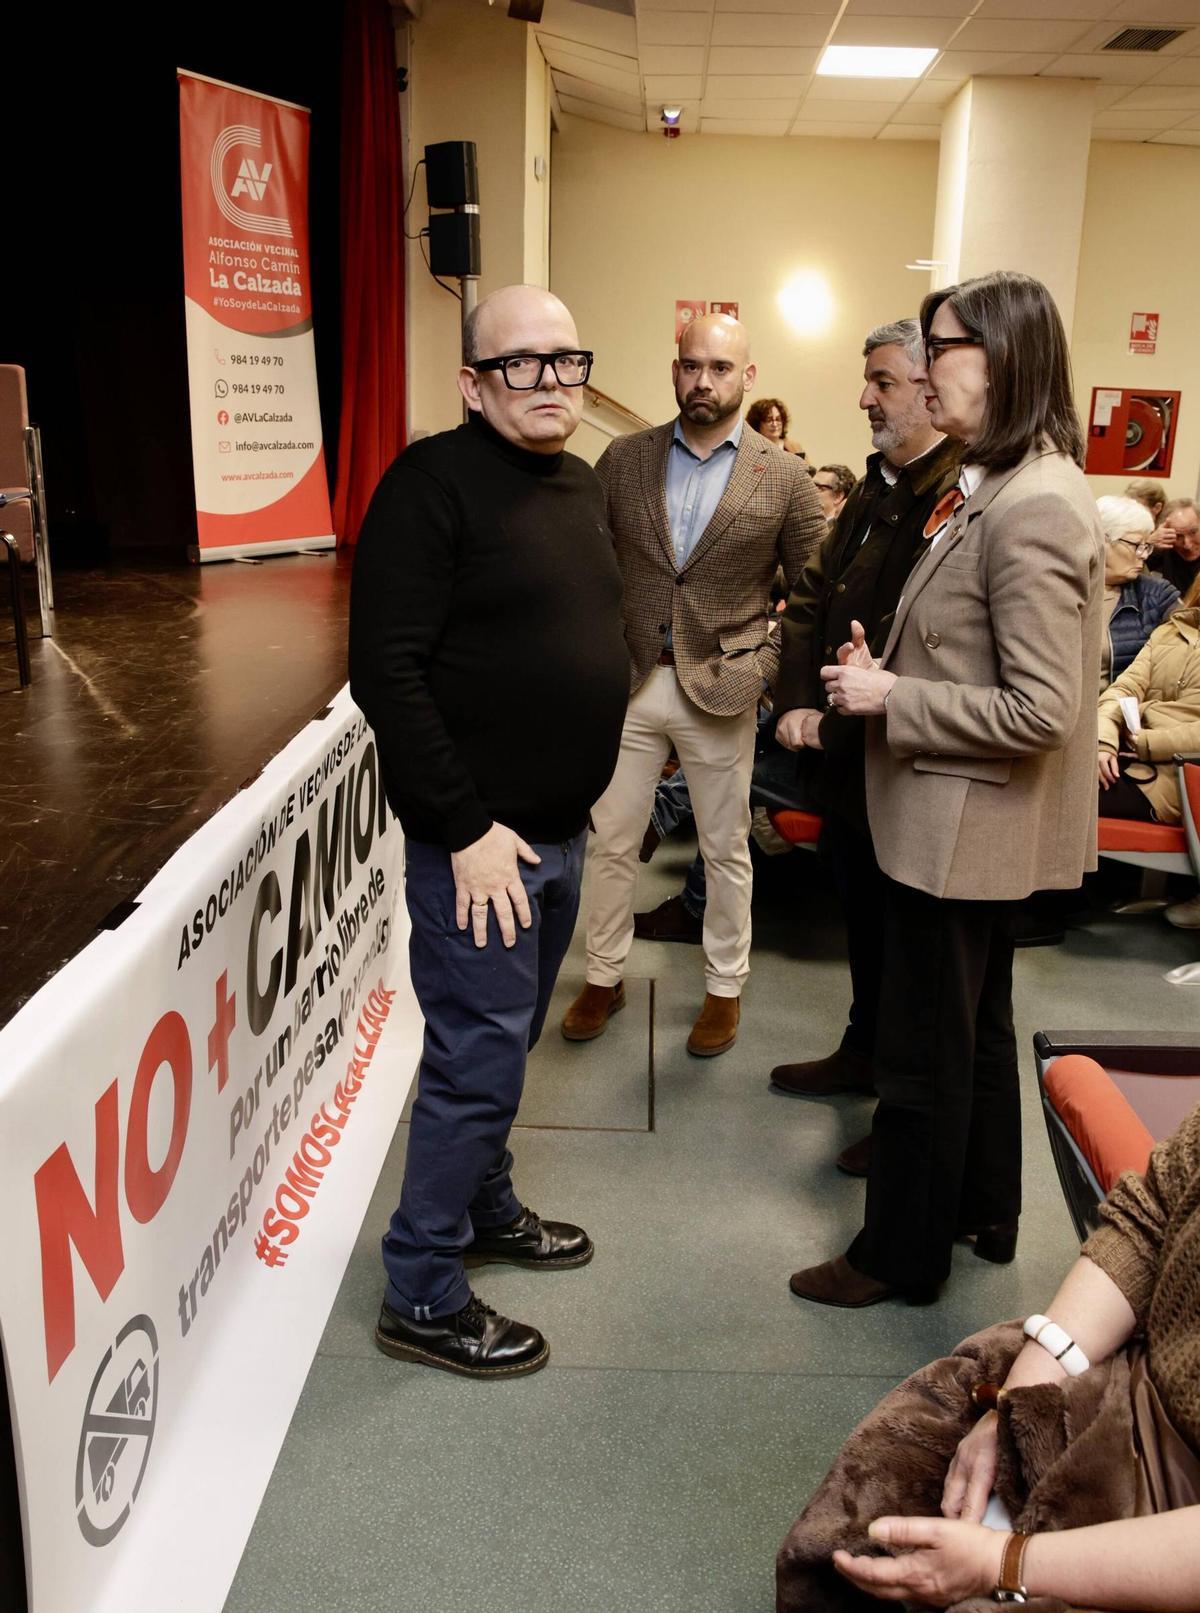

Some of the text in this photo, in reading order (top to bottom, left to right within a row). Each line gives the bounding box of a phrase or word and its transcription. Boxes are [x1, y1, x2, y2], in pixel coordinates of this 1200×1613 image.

[231, 158, 273, 201] AV
[208, 236, 299, 258] ASOCIACIÓN VECINAL
[209, 250, 257, 270] Alfonso
[209, 267, 303, 297] La Calzada
[213, 296, 301, 314] #YoSoydeLaCalzada
[230, 354, 284, 367] 984 19 49 70
[232, 383, 285, 395] 984 19 49 70
[233, 412, 294, 424] @AVLaCalzada
[235, 440, 315, 452] info@avcalzada.com
[221, 471, 295, 483] www.avcalzada.com
[177, 815, 278, 972] ASOCIACIÓN
[278, 793, 296, 838] DE
[228, 1065, 263, 1161] Por
[265, 1024, 292, 1088] un
[293, 943, 341, 1044] barrio
[336, 893, 369, 961] libre
[367, 866, 385, 910] de
[33, 1010, 193, 1387] NO
[177, 1092, 292, 1339] transporte
